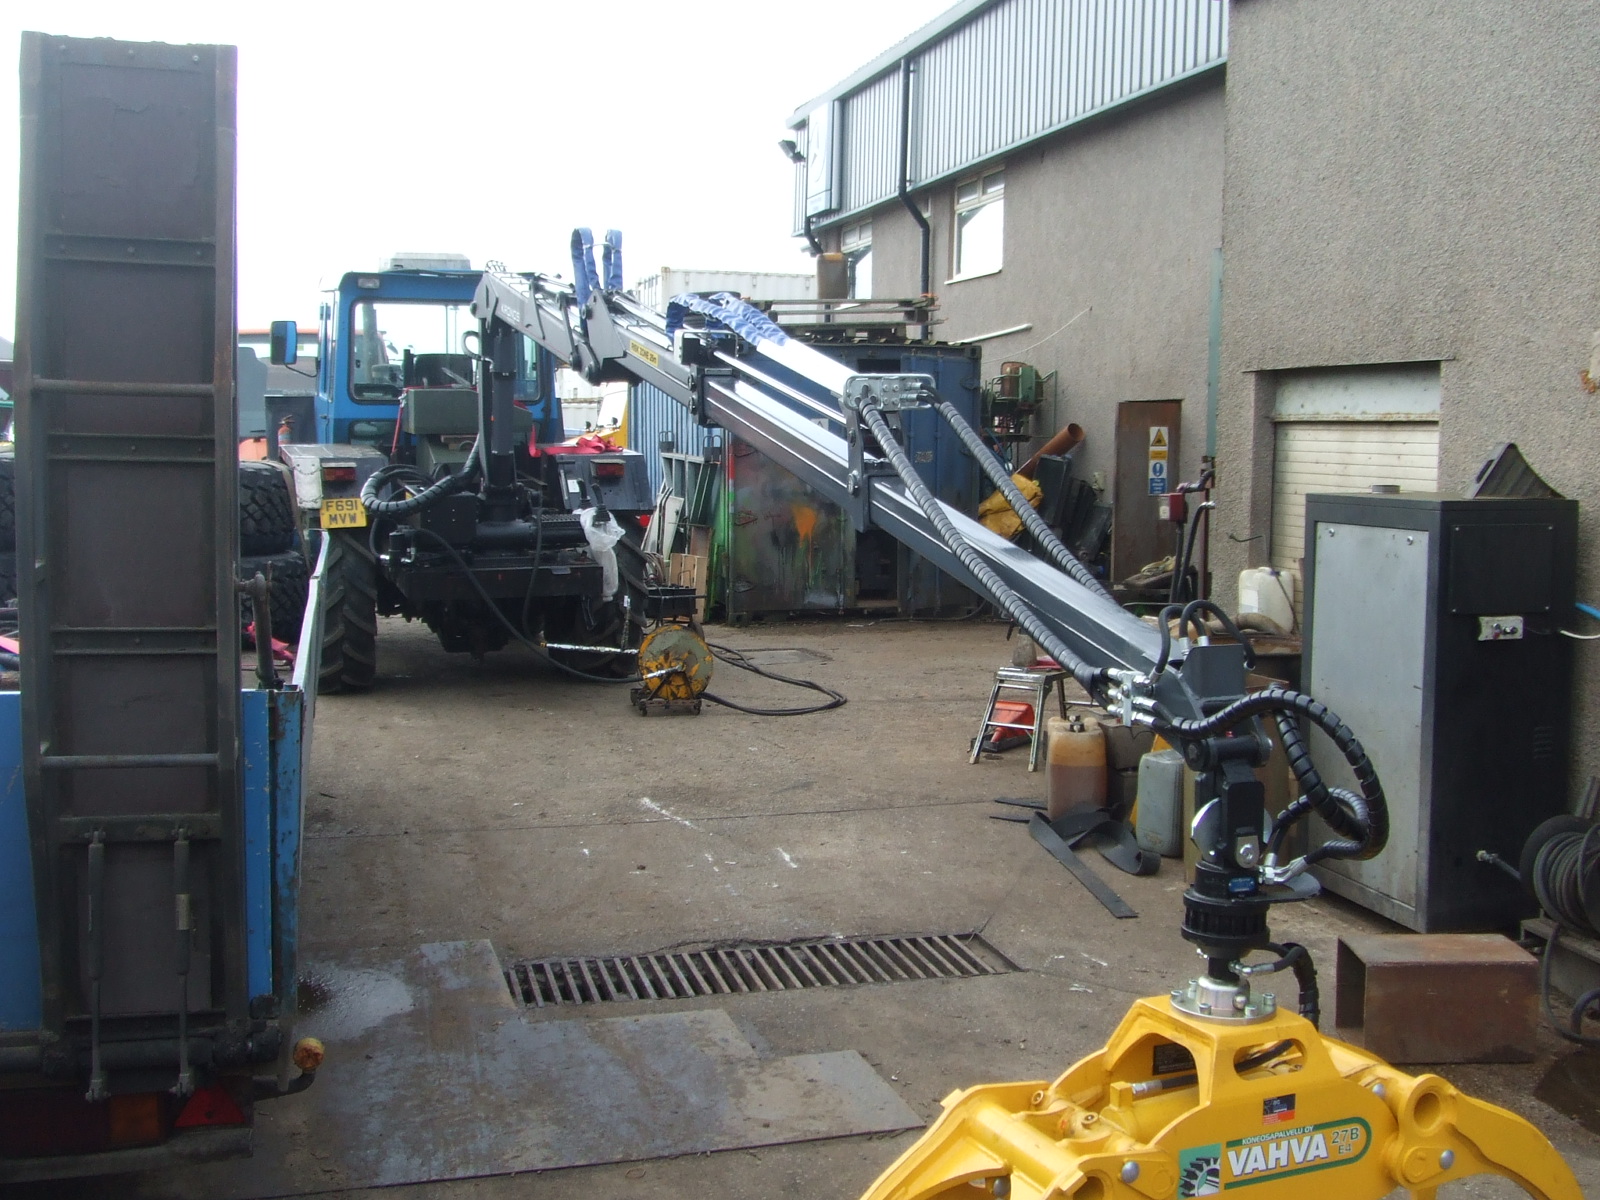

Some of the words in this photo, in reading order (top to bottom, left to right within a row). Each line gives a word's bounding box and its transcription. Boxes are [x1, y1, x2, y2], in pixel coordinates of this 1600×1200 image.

[639, 347, 649, 360] ZONE
[326, 500, 358, 512] F691
[329, 513, 357, 525] MVW
[1241, 1127, 1304, 1146] KONEOSAPALVELU
[1304, 1125, 1314, 1133] OY
[1332, 1127, 1359, 1144] 27B
[1227, 1133, 1329, 1176] VAHVA
[1338, 1143, 1352, 1155] E4
